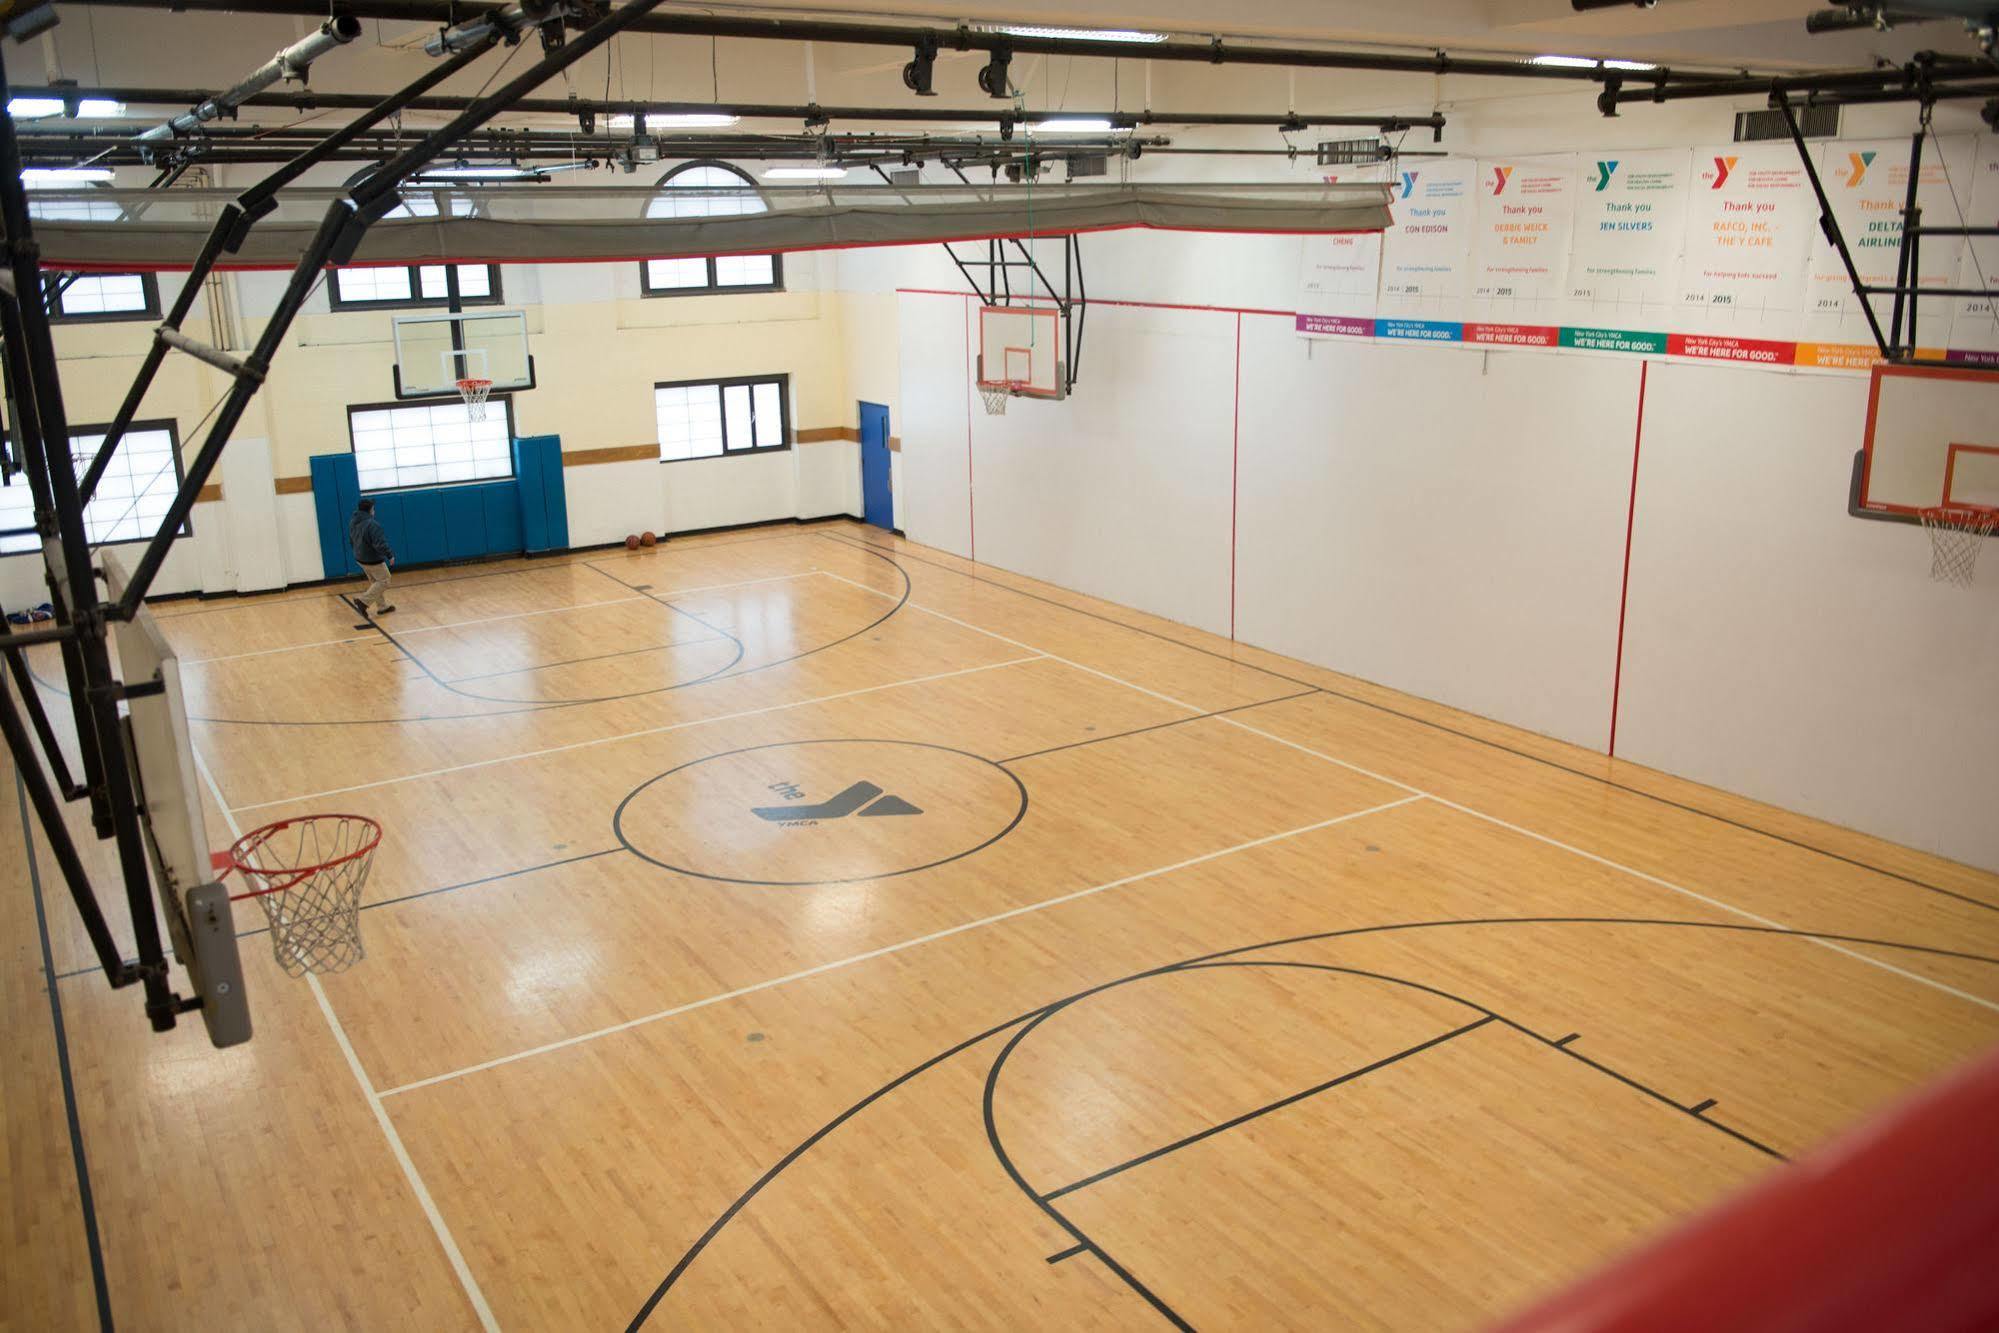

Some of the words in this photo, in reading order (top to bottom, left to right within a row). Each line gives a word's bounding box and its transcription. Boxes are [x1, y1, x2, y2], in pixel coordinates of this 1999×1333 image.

[1606, 202, 1632, 212] Thank
[1635, 203, 1652, 214] you
[1723, 201, 1752, 211] Thank
[1756, 203, 1776, 213] you
[1860, 200, 1895, 210] Thank
[1410, 208, 1431, 216] Thank
[1433, 209, 1446, 217] you
[1503, 205, 1525, 214] Thank
[1528, 206, 1543, 216] you
[1405, 225, 1420, 233] CON
[1422, 224, 1448, 233] EDISON
[1600, 222, 1616, 231] JEN
[1618, 221, 1653, 231] SILVERS
[1869, 221, 1904, 232] DELTA
[1511, 236, 1538, 245] FAMILY
[1497, 288, 1512, 296] 2015
[1574, 289, 1591, 297] 2015
[1712, 295, 1732, 304] 2015
[1817, 300, 1838, 308] 2014
[1967, 303, 1990, 312] 2014
[1387, 328, 1404, 336] WE'RE
[1405, 329, 1419, 337] HERE
[1420, 330, 1432, 338] FOR
[1476, 333, 1494, 342] WE'RE
[1495, 334, 1512, 343] HERE
[1513, 335, 1526, 344] FOR
[1574, 338, 1595, 347] WE'RE
[1597, 339, 1614, 348] HERE
[1616, 340, 1630, 350] FOR
[1631, 341, 1654, 351] GOOD.
[1685, 345, 1709, 356] WE'RE
[1710, 347, 1731, 357] HERE
[1732, 348, 1749, 359] FOR
[1749, 350, 1776, 361] GOOD.
[1965, 351, 1979, 362] New
[1980, 351, 1995, 363] York
[778, 819, 819, 828] YMCA
